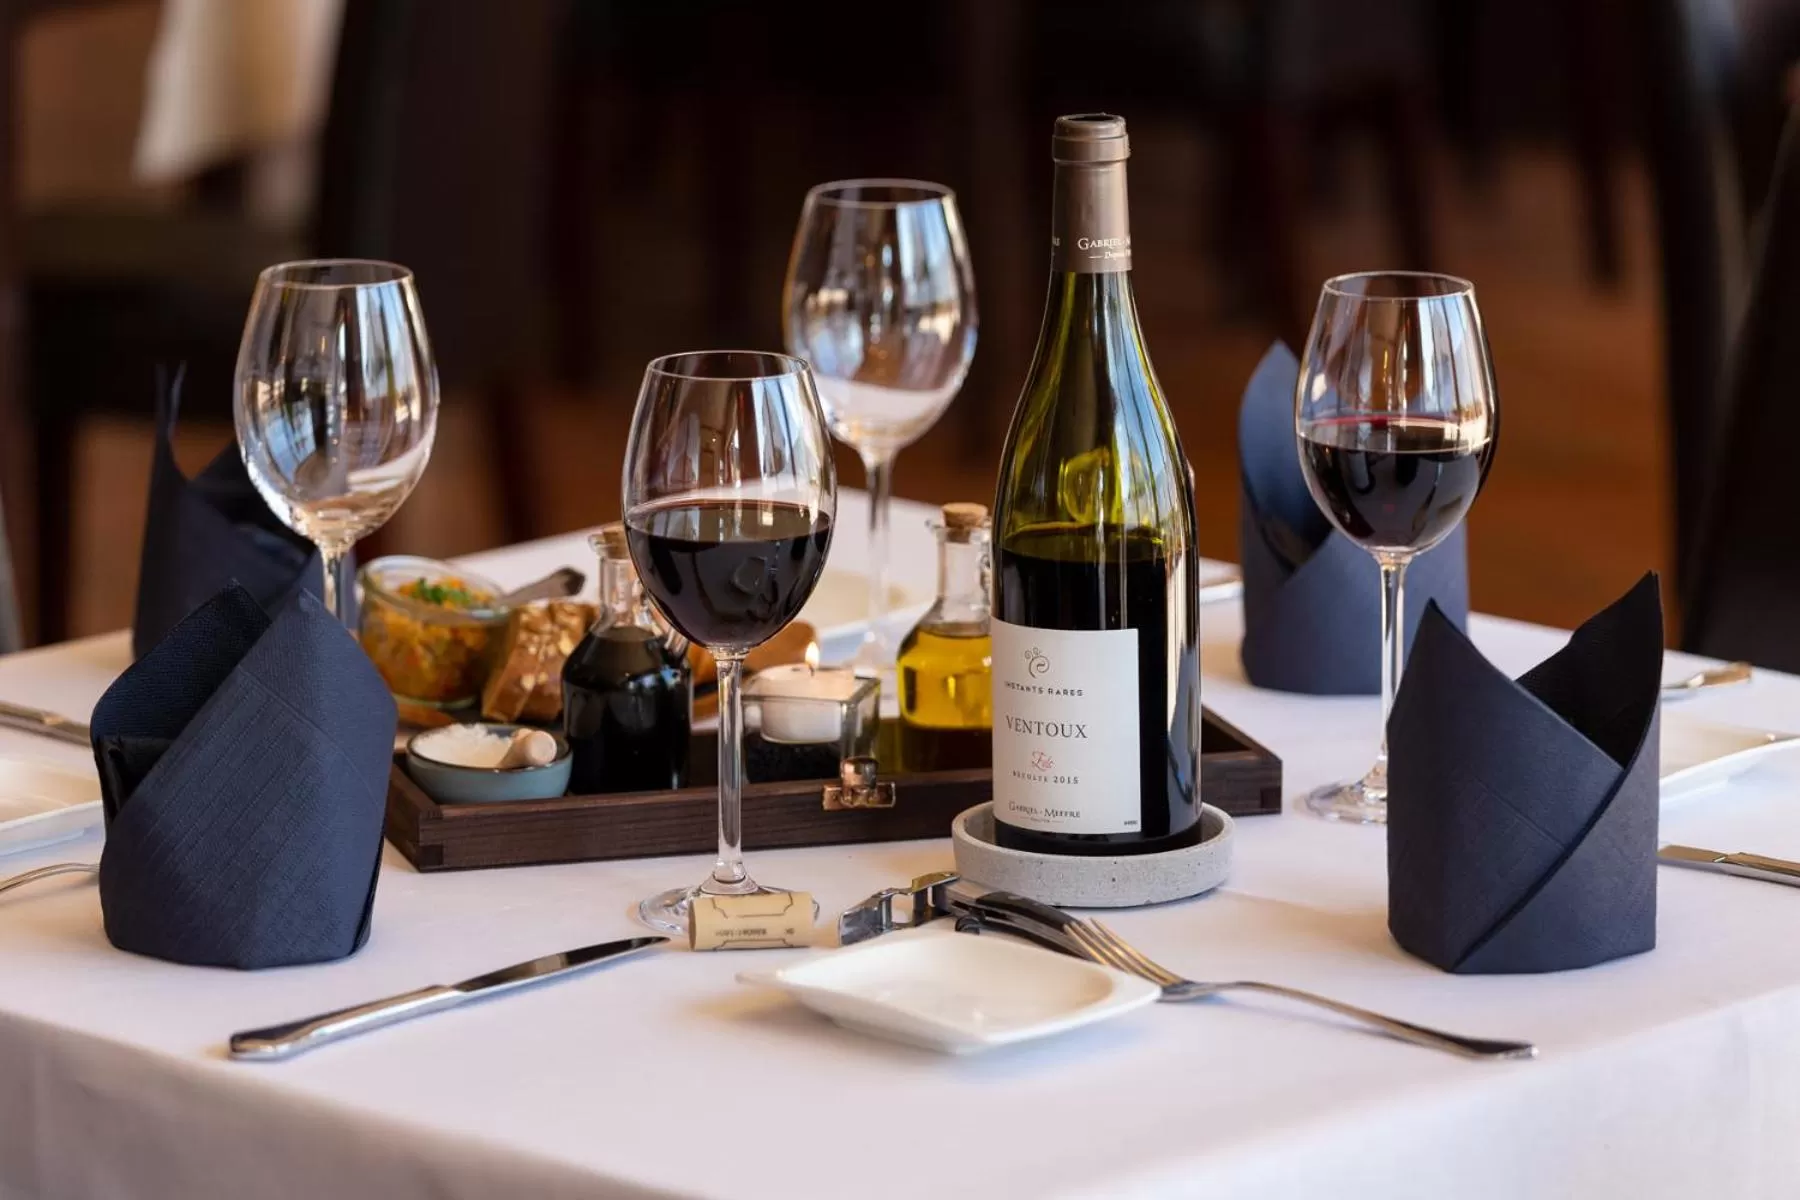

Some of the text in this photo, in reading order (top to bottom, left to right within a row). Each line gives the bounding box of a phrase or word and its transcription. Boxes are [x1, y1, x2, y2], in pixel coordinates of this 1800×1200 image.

[1047, 687, 1083, 697] RARES
[1006, 715, 1088, 739] VENTOUX
[1053, 775, 1079, 785] 2015
